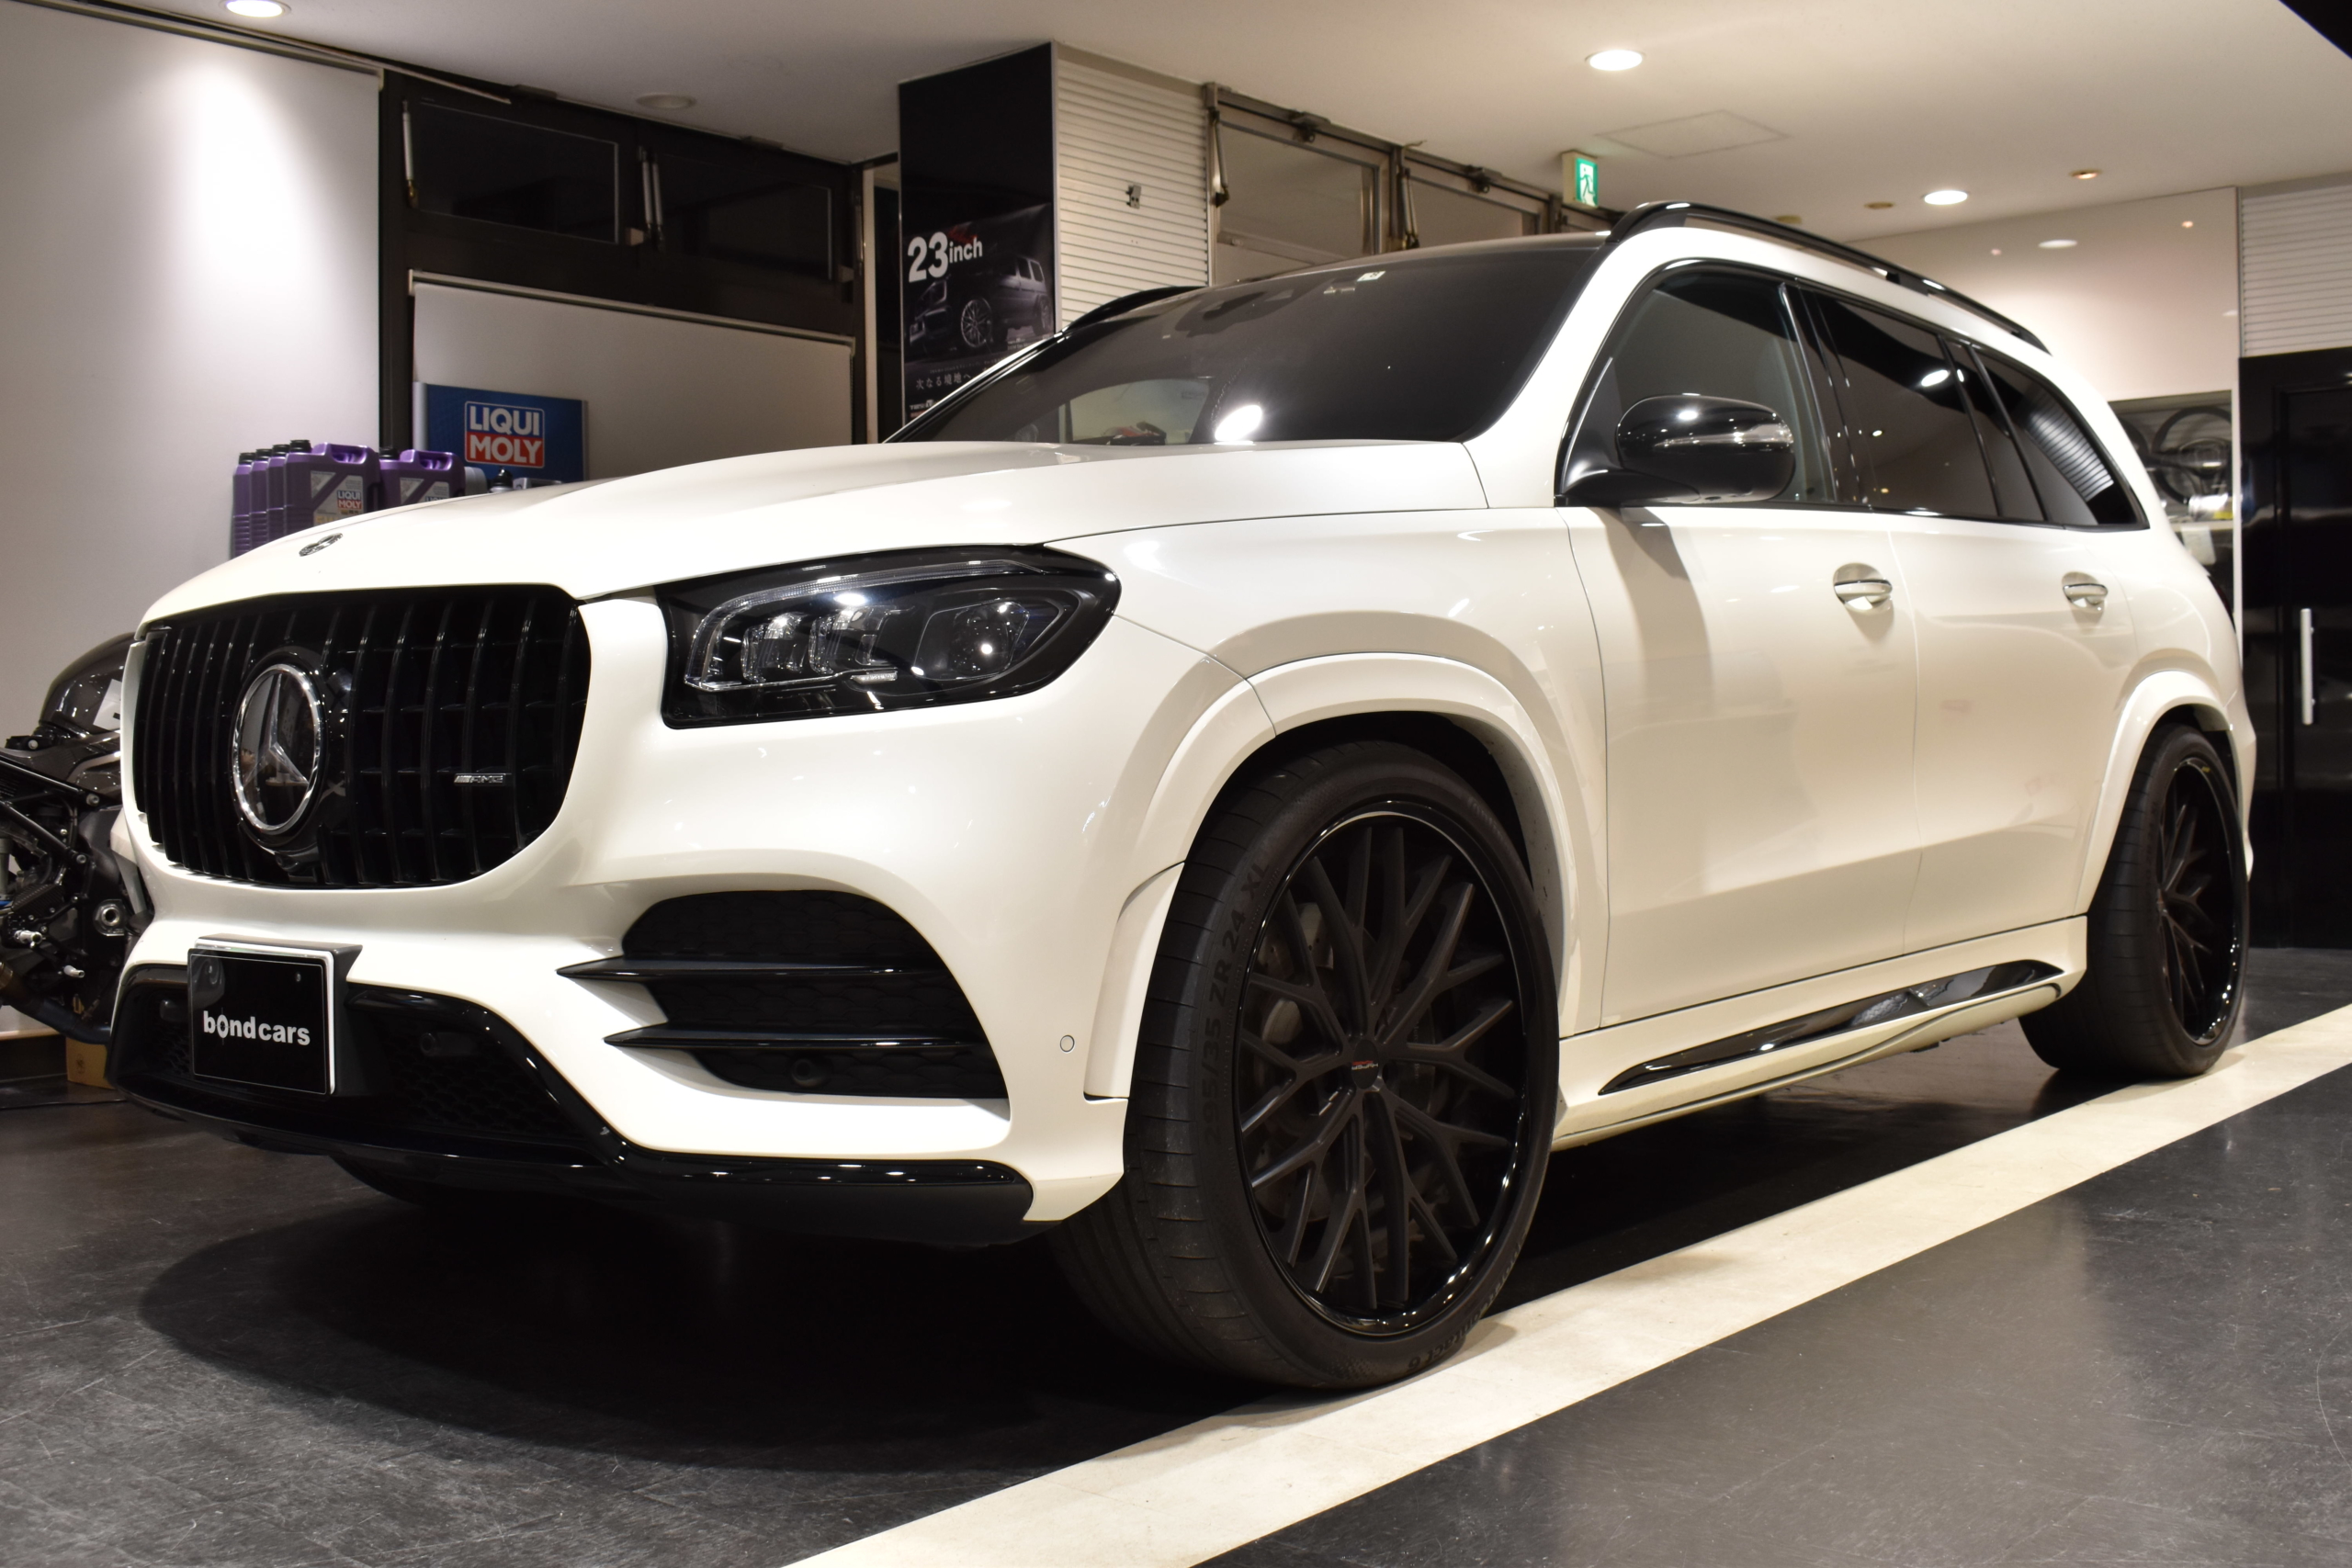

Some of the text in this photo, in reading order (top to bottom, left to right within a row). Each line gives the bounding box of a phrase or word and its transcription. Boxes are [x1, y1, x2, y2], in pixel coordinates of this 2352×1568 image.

[469, 405, 540, 436] LIQUI
[469, 434, 543, 465] MOLY
[337, 491, 361, 501] LIQUI
[338, 500, 362, 509] MOLY
[1208, 960, 1232, 1008] ZR
[1222, 908, 1249, 953] 24
[1240, 863, 1270, 900] XL
